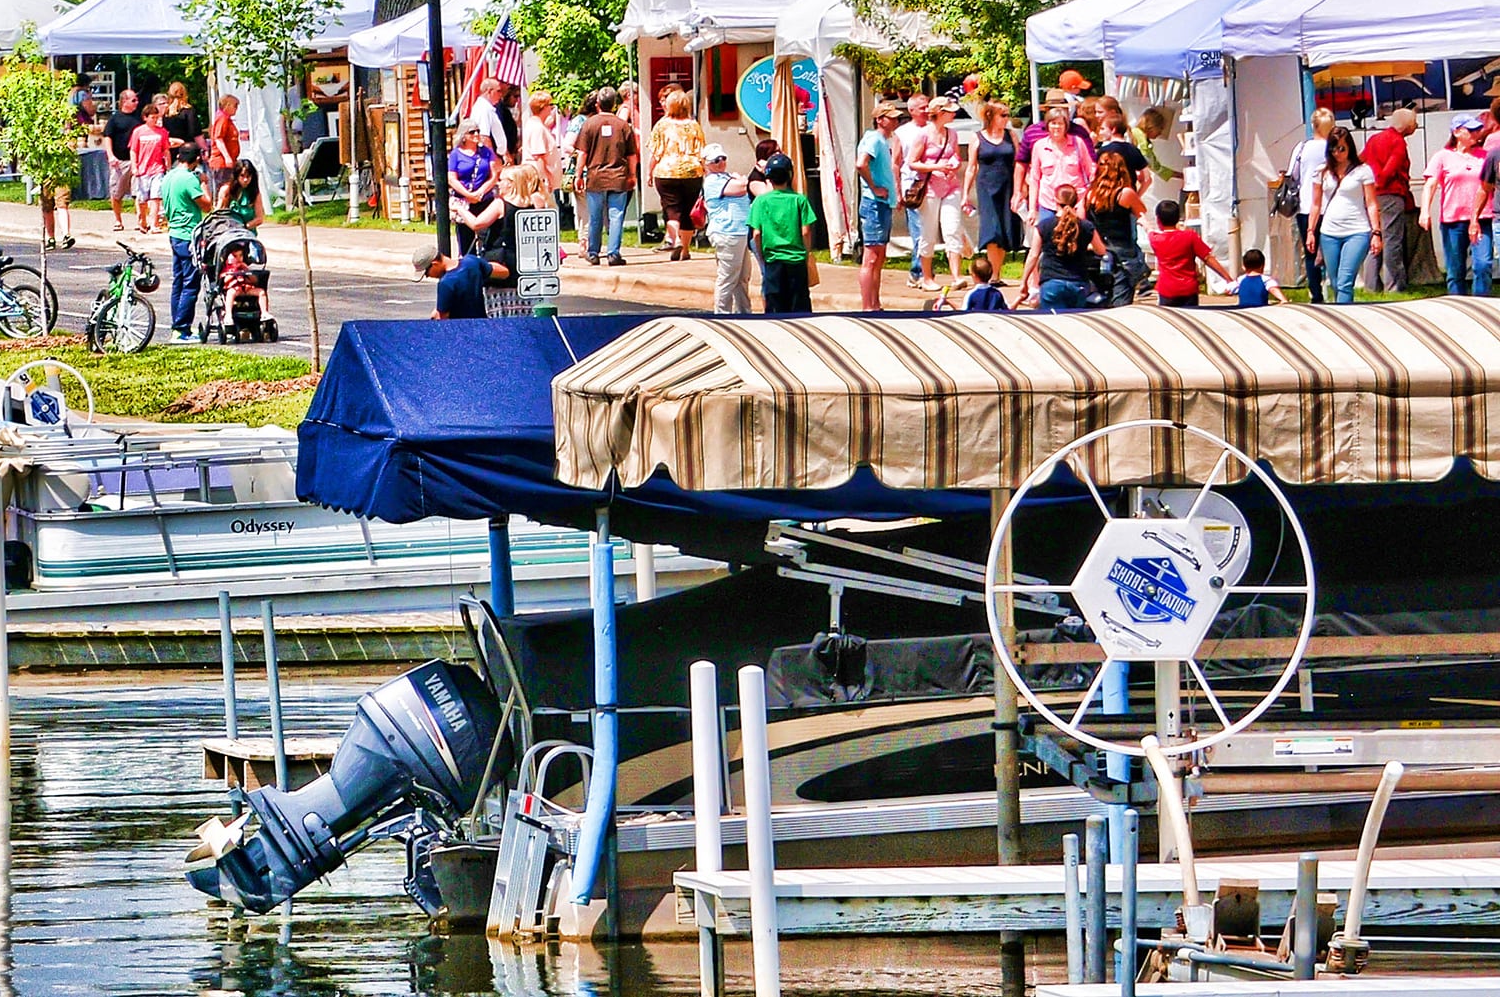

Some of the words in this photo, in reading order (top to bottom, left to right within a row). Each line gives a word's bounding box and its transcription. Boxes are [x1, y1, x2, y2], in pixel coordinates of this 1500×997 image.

[521, 235, 535, 245] LEFT
[538, 235, 556, 244] RIGHT
[522, 216, 552, 232] KEEP
[1109, 562, 1149, 593] SHORE
[1152, 586, 1193, 617] STATION
[424, 672, 468, 733] YAMAHA
